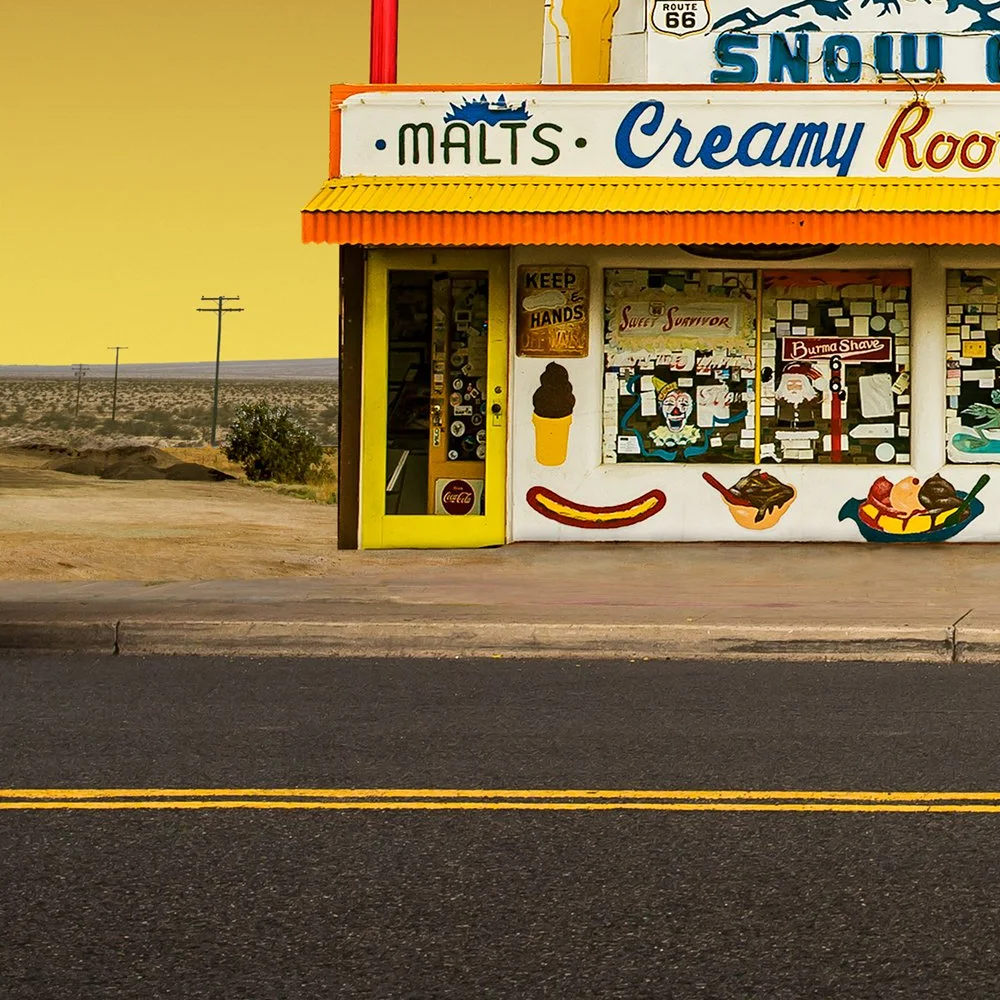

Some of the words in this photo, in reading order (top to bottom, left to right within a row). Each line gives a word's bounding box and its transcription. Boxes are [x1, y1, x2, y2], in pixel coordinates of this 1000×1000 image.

[662, 3, 698, 11] ROUTE
[665, 12, 696, 29] 66
[710, 32, 943, 84] SNOW
[397, 120, 563, 166] MALTS
[615, 99, 865, 177] Creamy
[526, 272, 576, 289] KEEP
[531, 305, 585, 328] HANDS
[790, 340, 837, 360] Burma
[839, 339, 881, 353] Shave
